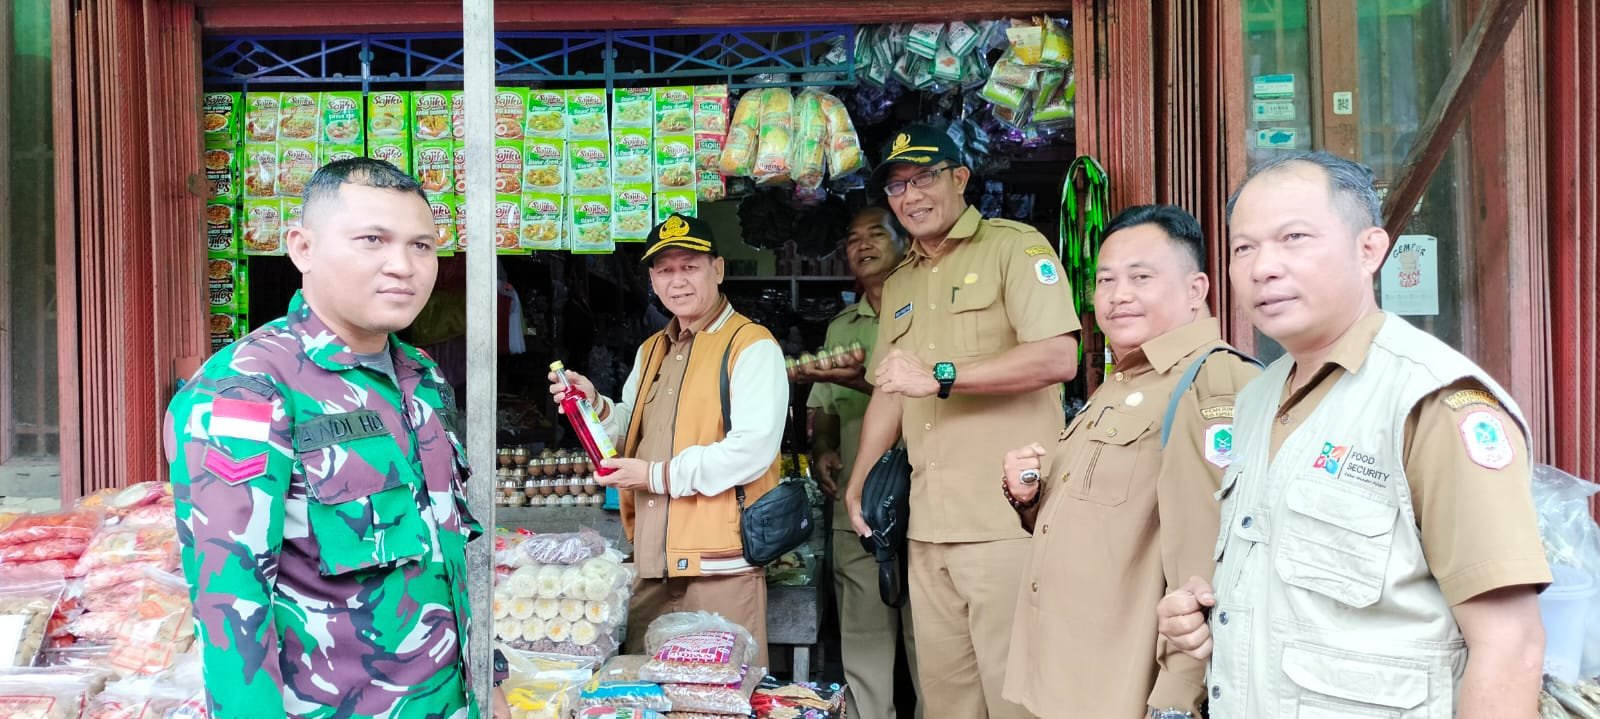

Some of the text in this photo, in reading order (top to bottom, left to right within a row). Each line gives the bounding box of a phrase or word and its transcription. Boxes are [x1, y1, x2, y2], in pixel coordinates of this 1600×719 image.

[327, 100, 355, 114] Sajiku
[372, 95, 403, 107] Sajiku
[416, 96, 446, 109] Sajiku
[582, 204, 606, 216] Sajiku
[1393, 243, 1426, 258] GEMPUR
[1351, 451, 1375, 465] FOOD
[1347, 462, 1391, 482] SECURITY
